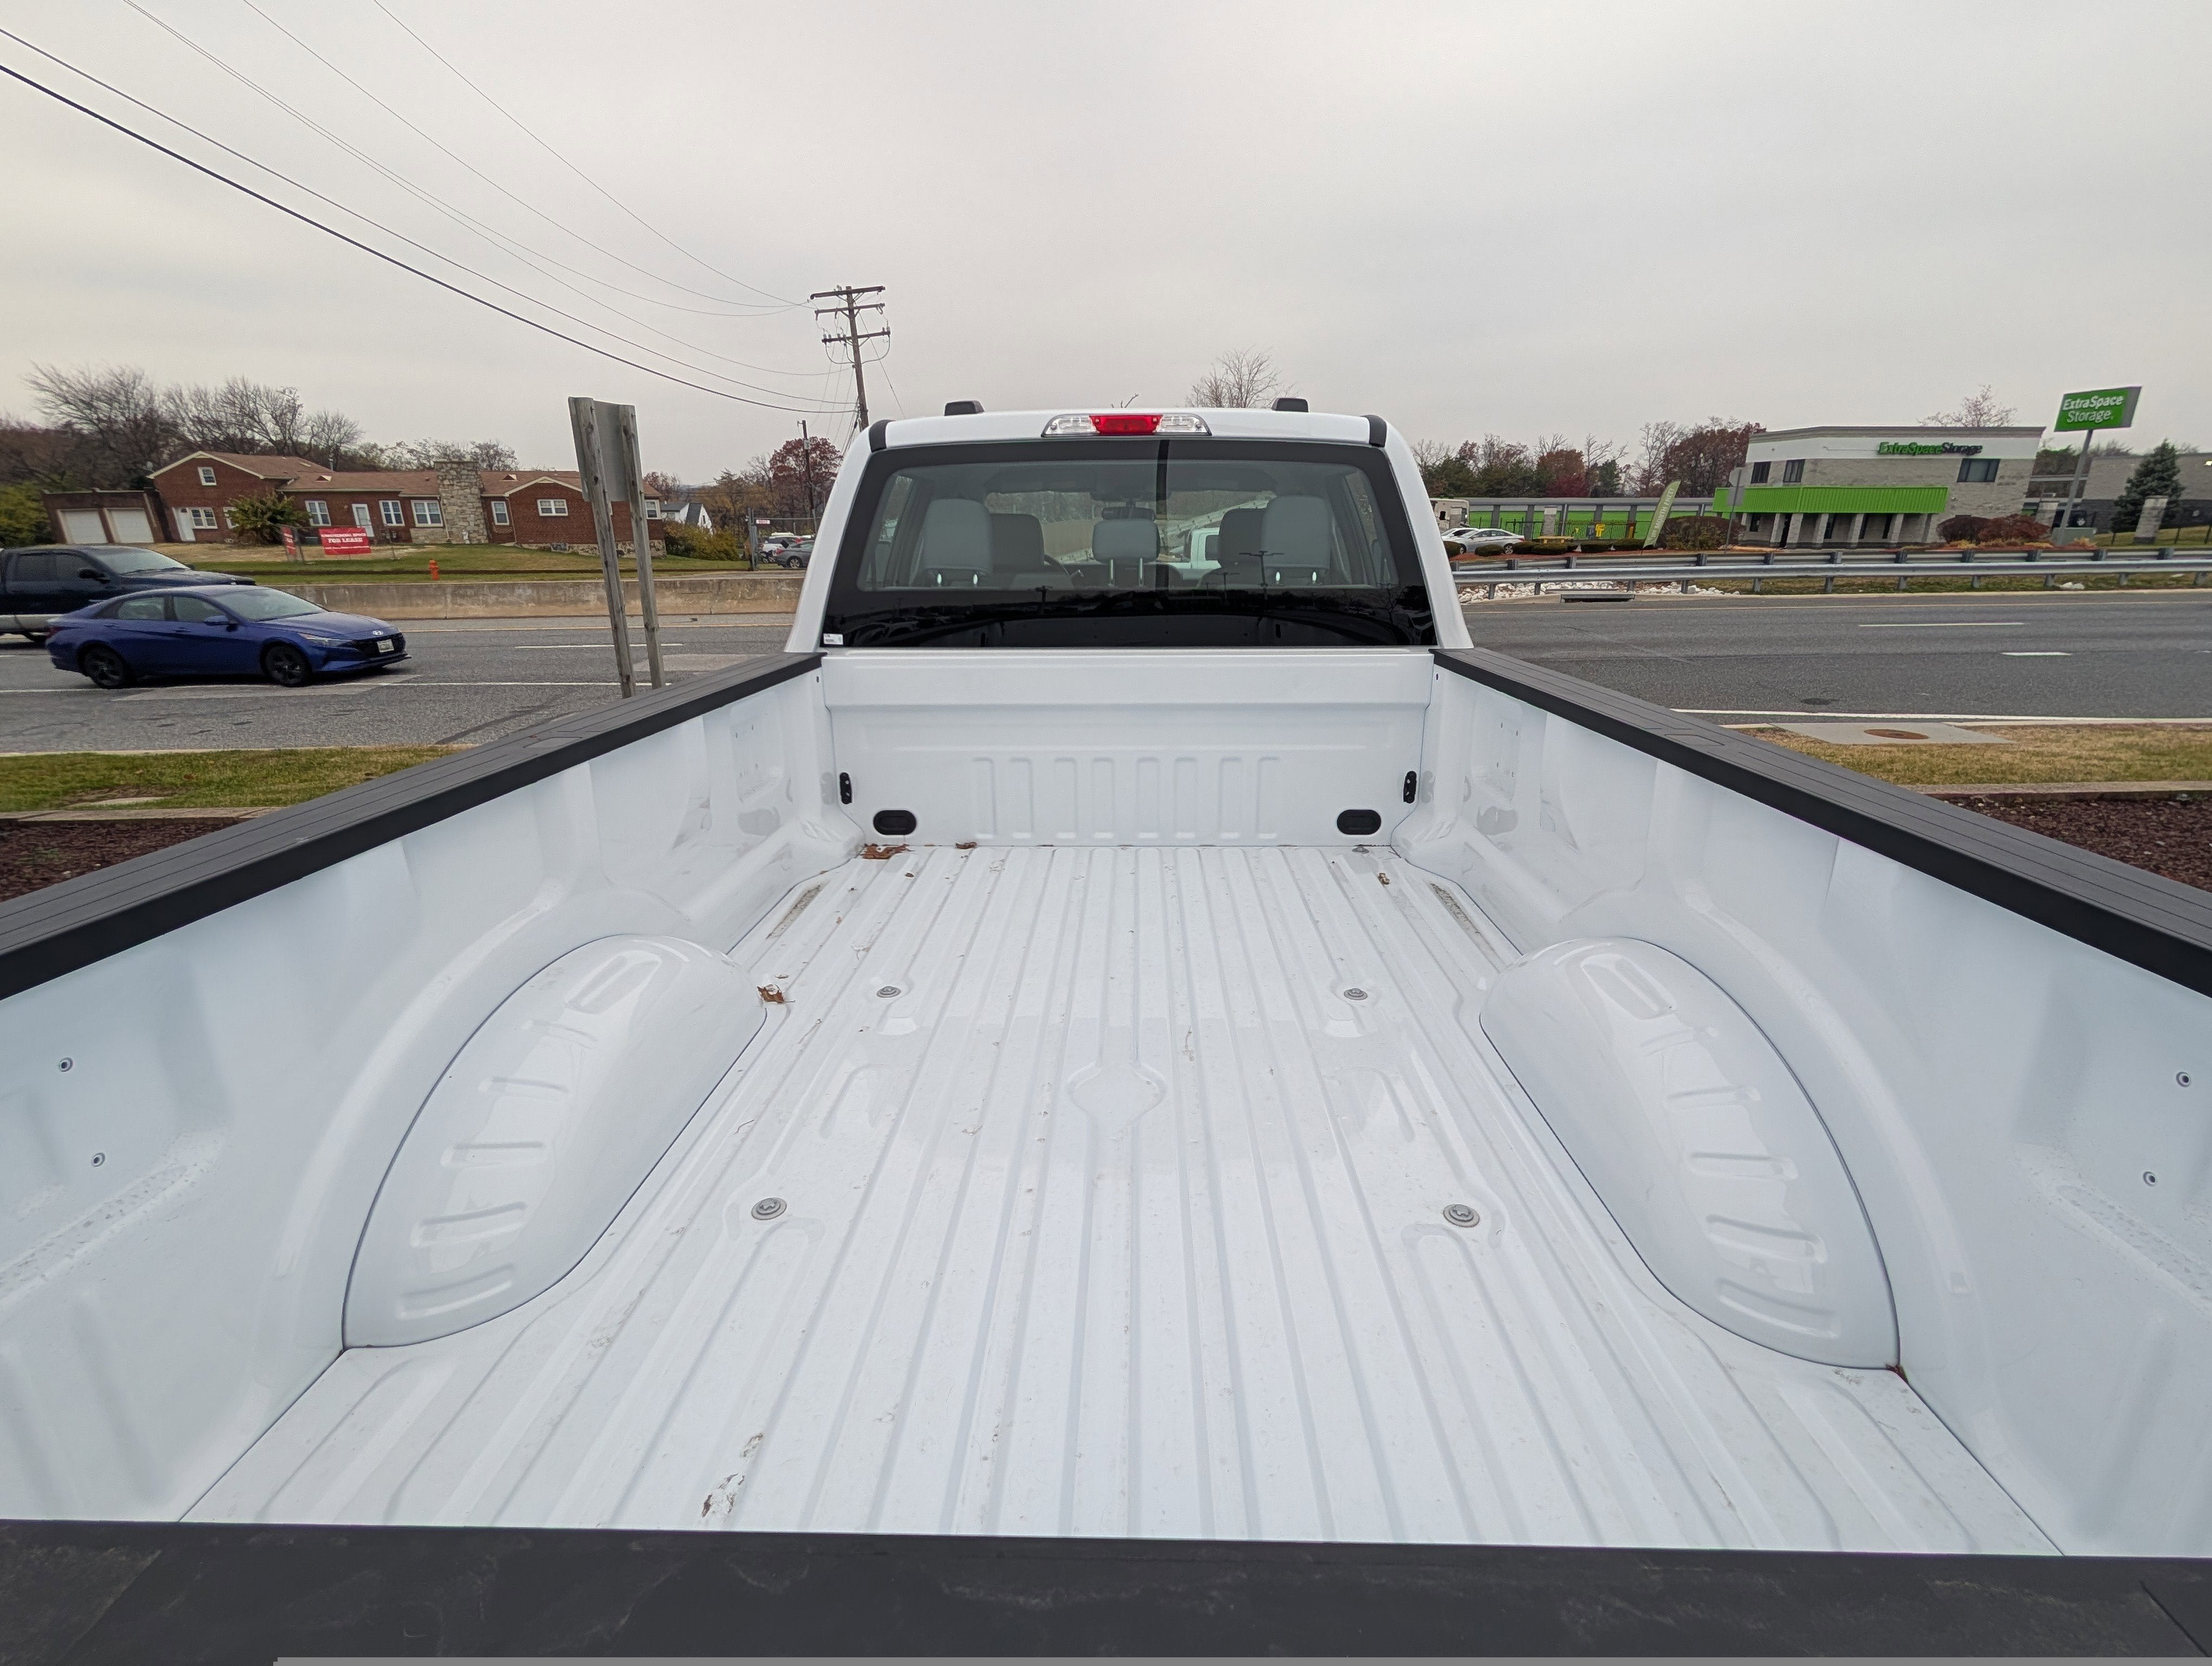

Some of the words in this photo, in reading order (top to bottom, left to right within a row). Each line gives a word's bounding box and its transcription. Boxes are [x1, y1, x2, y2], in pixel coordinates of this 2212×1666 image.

[2062, 395, 2124, 410] ExtraSpace
[2067, 410, 2111, 423] Storage
[1654, 507, 1668, 529] MONTH
